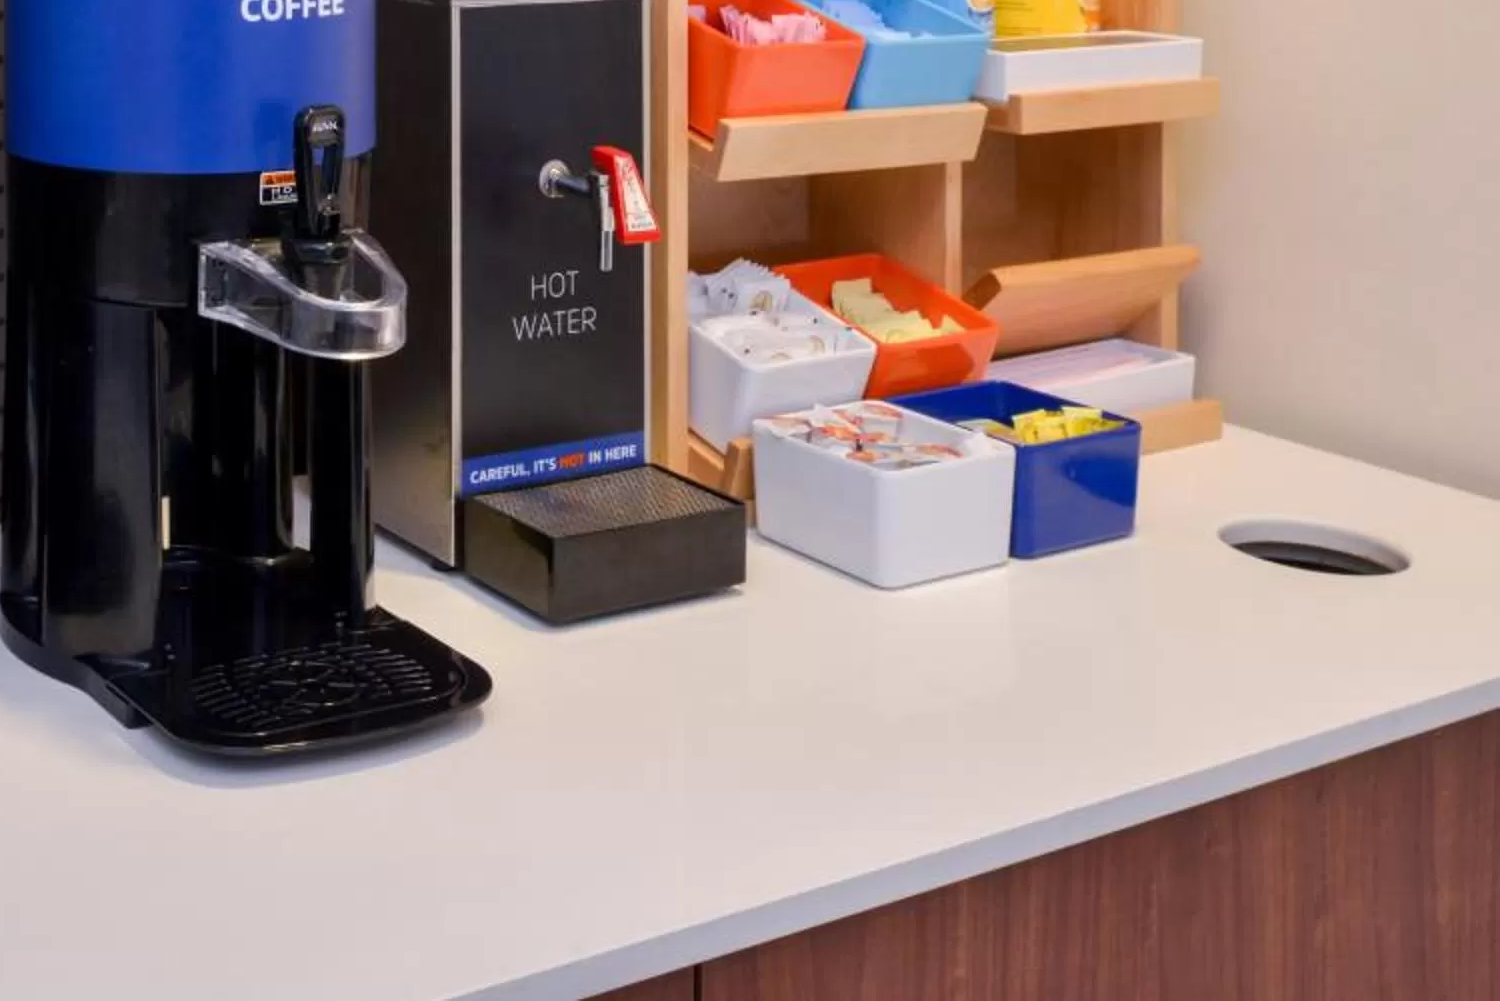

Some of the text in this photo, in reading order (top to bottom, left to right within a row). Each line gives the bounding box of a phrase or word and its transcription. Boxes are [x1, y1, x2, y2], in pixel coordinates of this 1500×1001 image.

[531, 270, 580, 301] HOT
[512, 306, 598, 341] WATER
[469, 444, 637, 484] CAREFUL, IT'S HOT IN HERE
